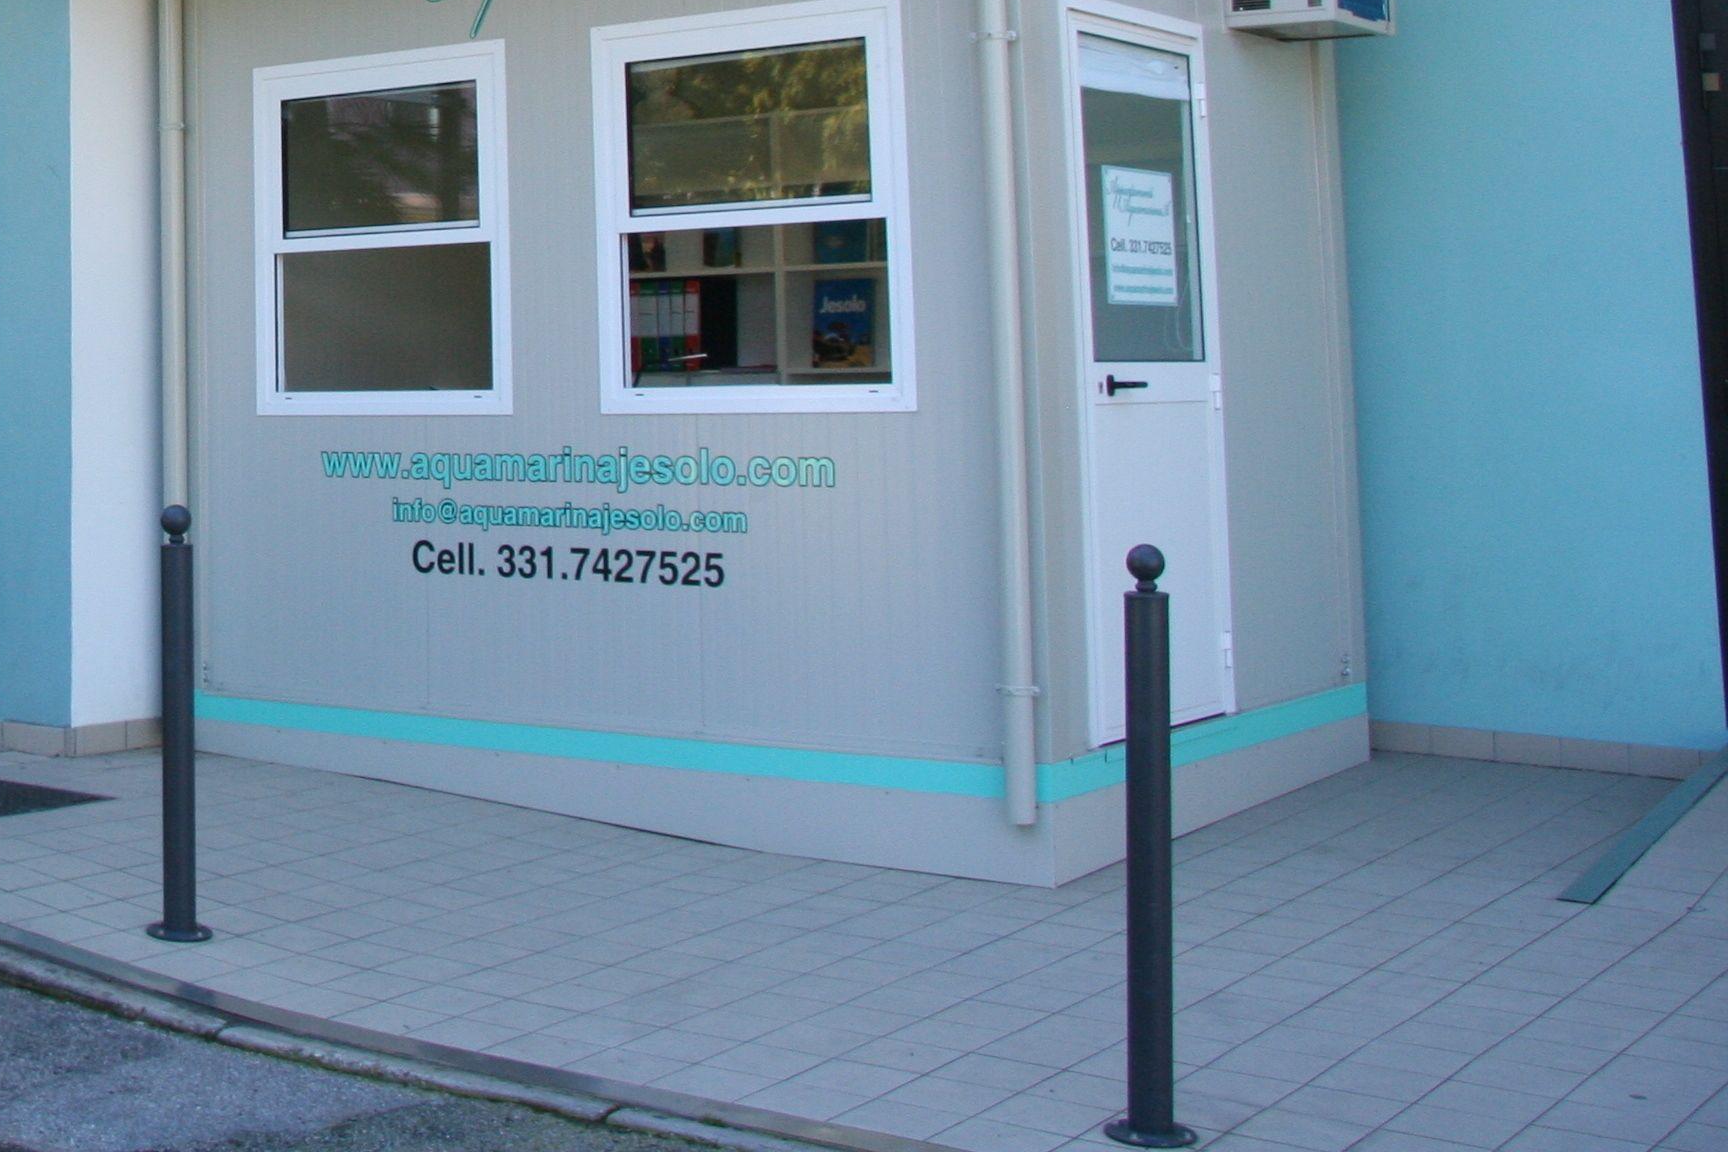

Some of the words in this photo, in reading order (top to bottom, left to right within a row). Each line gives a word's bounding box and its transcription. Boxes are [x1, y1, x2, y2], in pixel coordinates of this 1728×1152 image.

[320, 446, 836, 493] www.aquamarinajesolo.com
[392, 496, 748, 535] info@aquamarinajesolo.com
[411, 539, 486, 576] Cell.
[496, 544, 725, 587] 331.7427525
